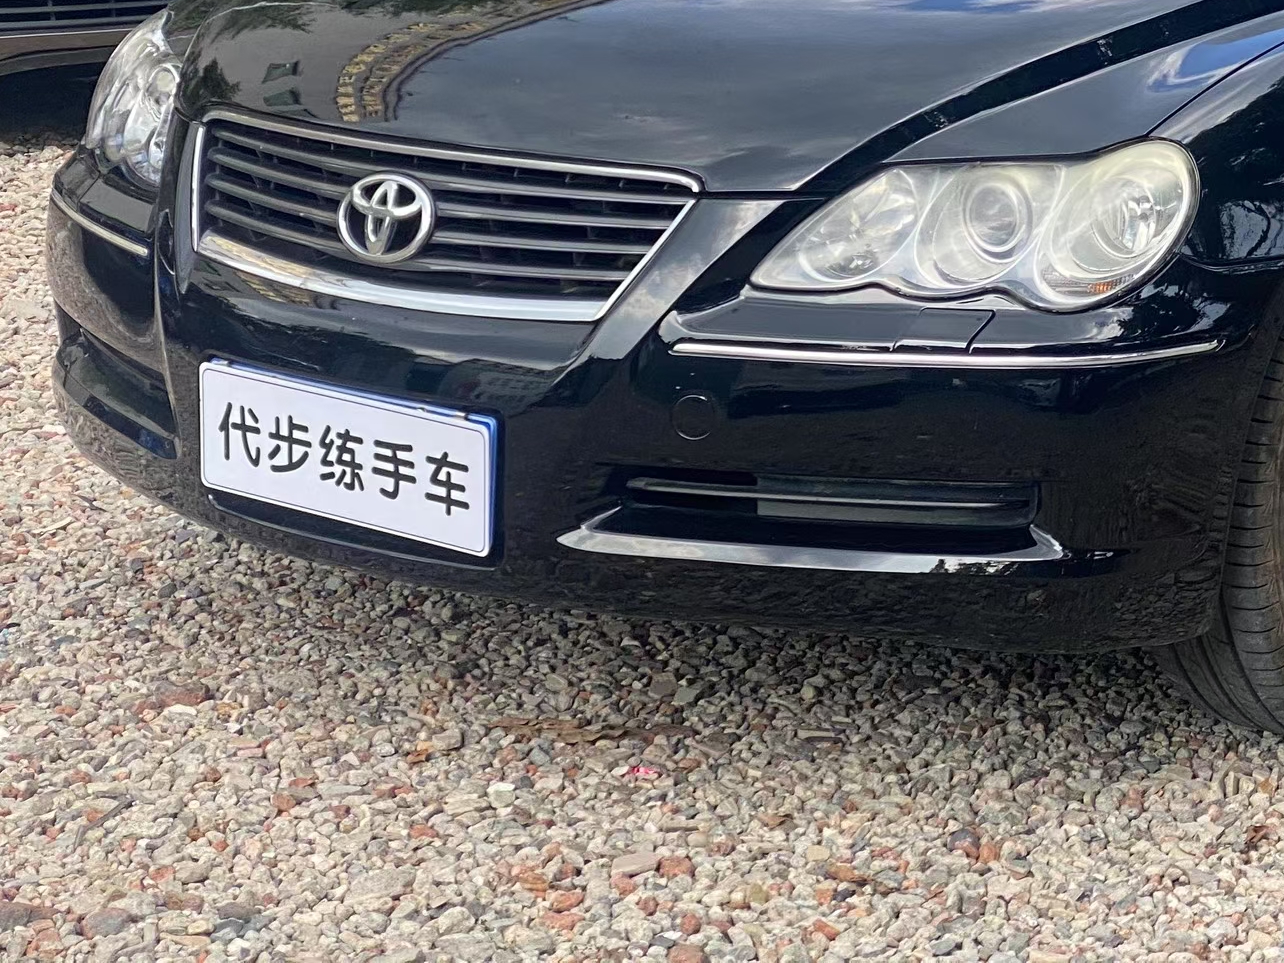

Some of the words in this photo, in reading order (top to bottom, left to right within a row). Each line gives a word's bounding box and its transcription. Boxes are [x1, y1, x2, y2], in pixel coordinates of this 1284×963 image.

[218, 401, 470, 516] 代步练手车
